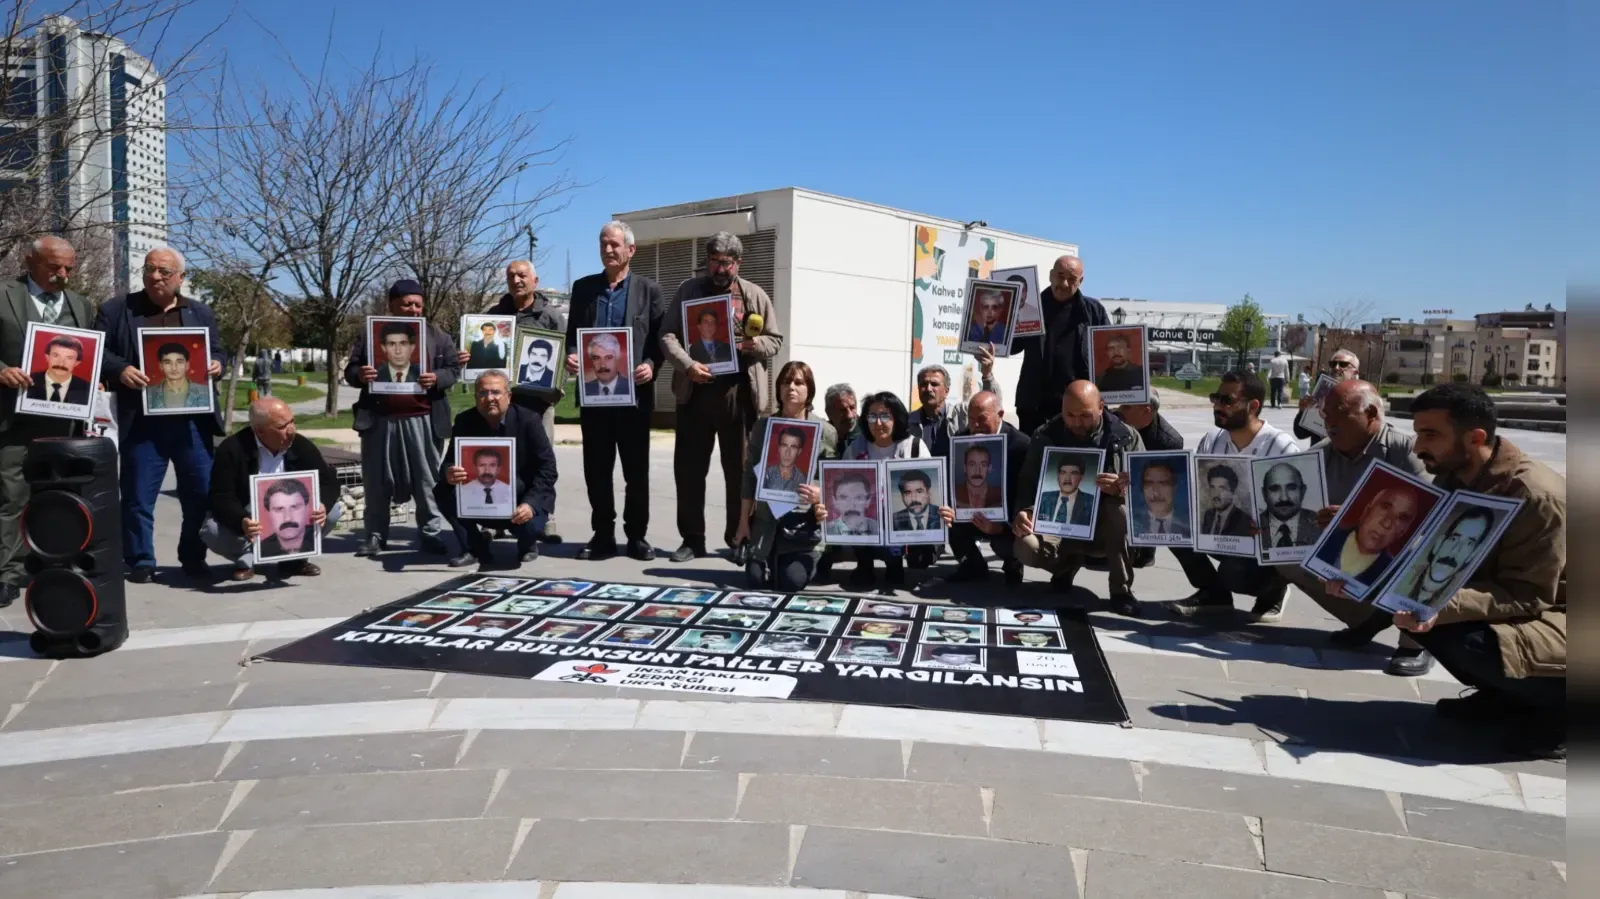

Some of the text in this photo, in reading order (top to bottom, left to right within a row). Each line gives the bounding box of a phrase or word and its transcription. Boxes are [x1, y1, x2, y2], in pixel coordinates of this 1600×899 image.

[932, 285, 955, 298] Kahve
[938, 303, 963, 315] yenile
[933, 318, 960, 333] konsep
[1187, 330, 1215, 342] Dyarı
[1139, 533, 1167, 541] MEHMET
[1169, 534, 1182, 542] ŞEN
[333, 630, 1084, 693] KAYIPLAR BULUNSUN FAİLLER YARGILANSIN
[692, 671, 770, 682] HAKLARI
